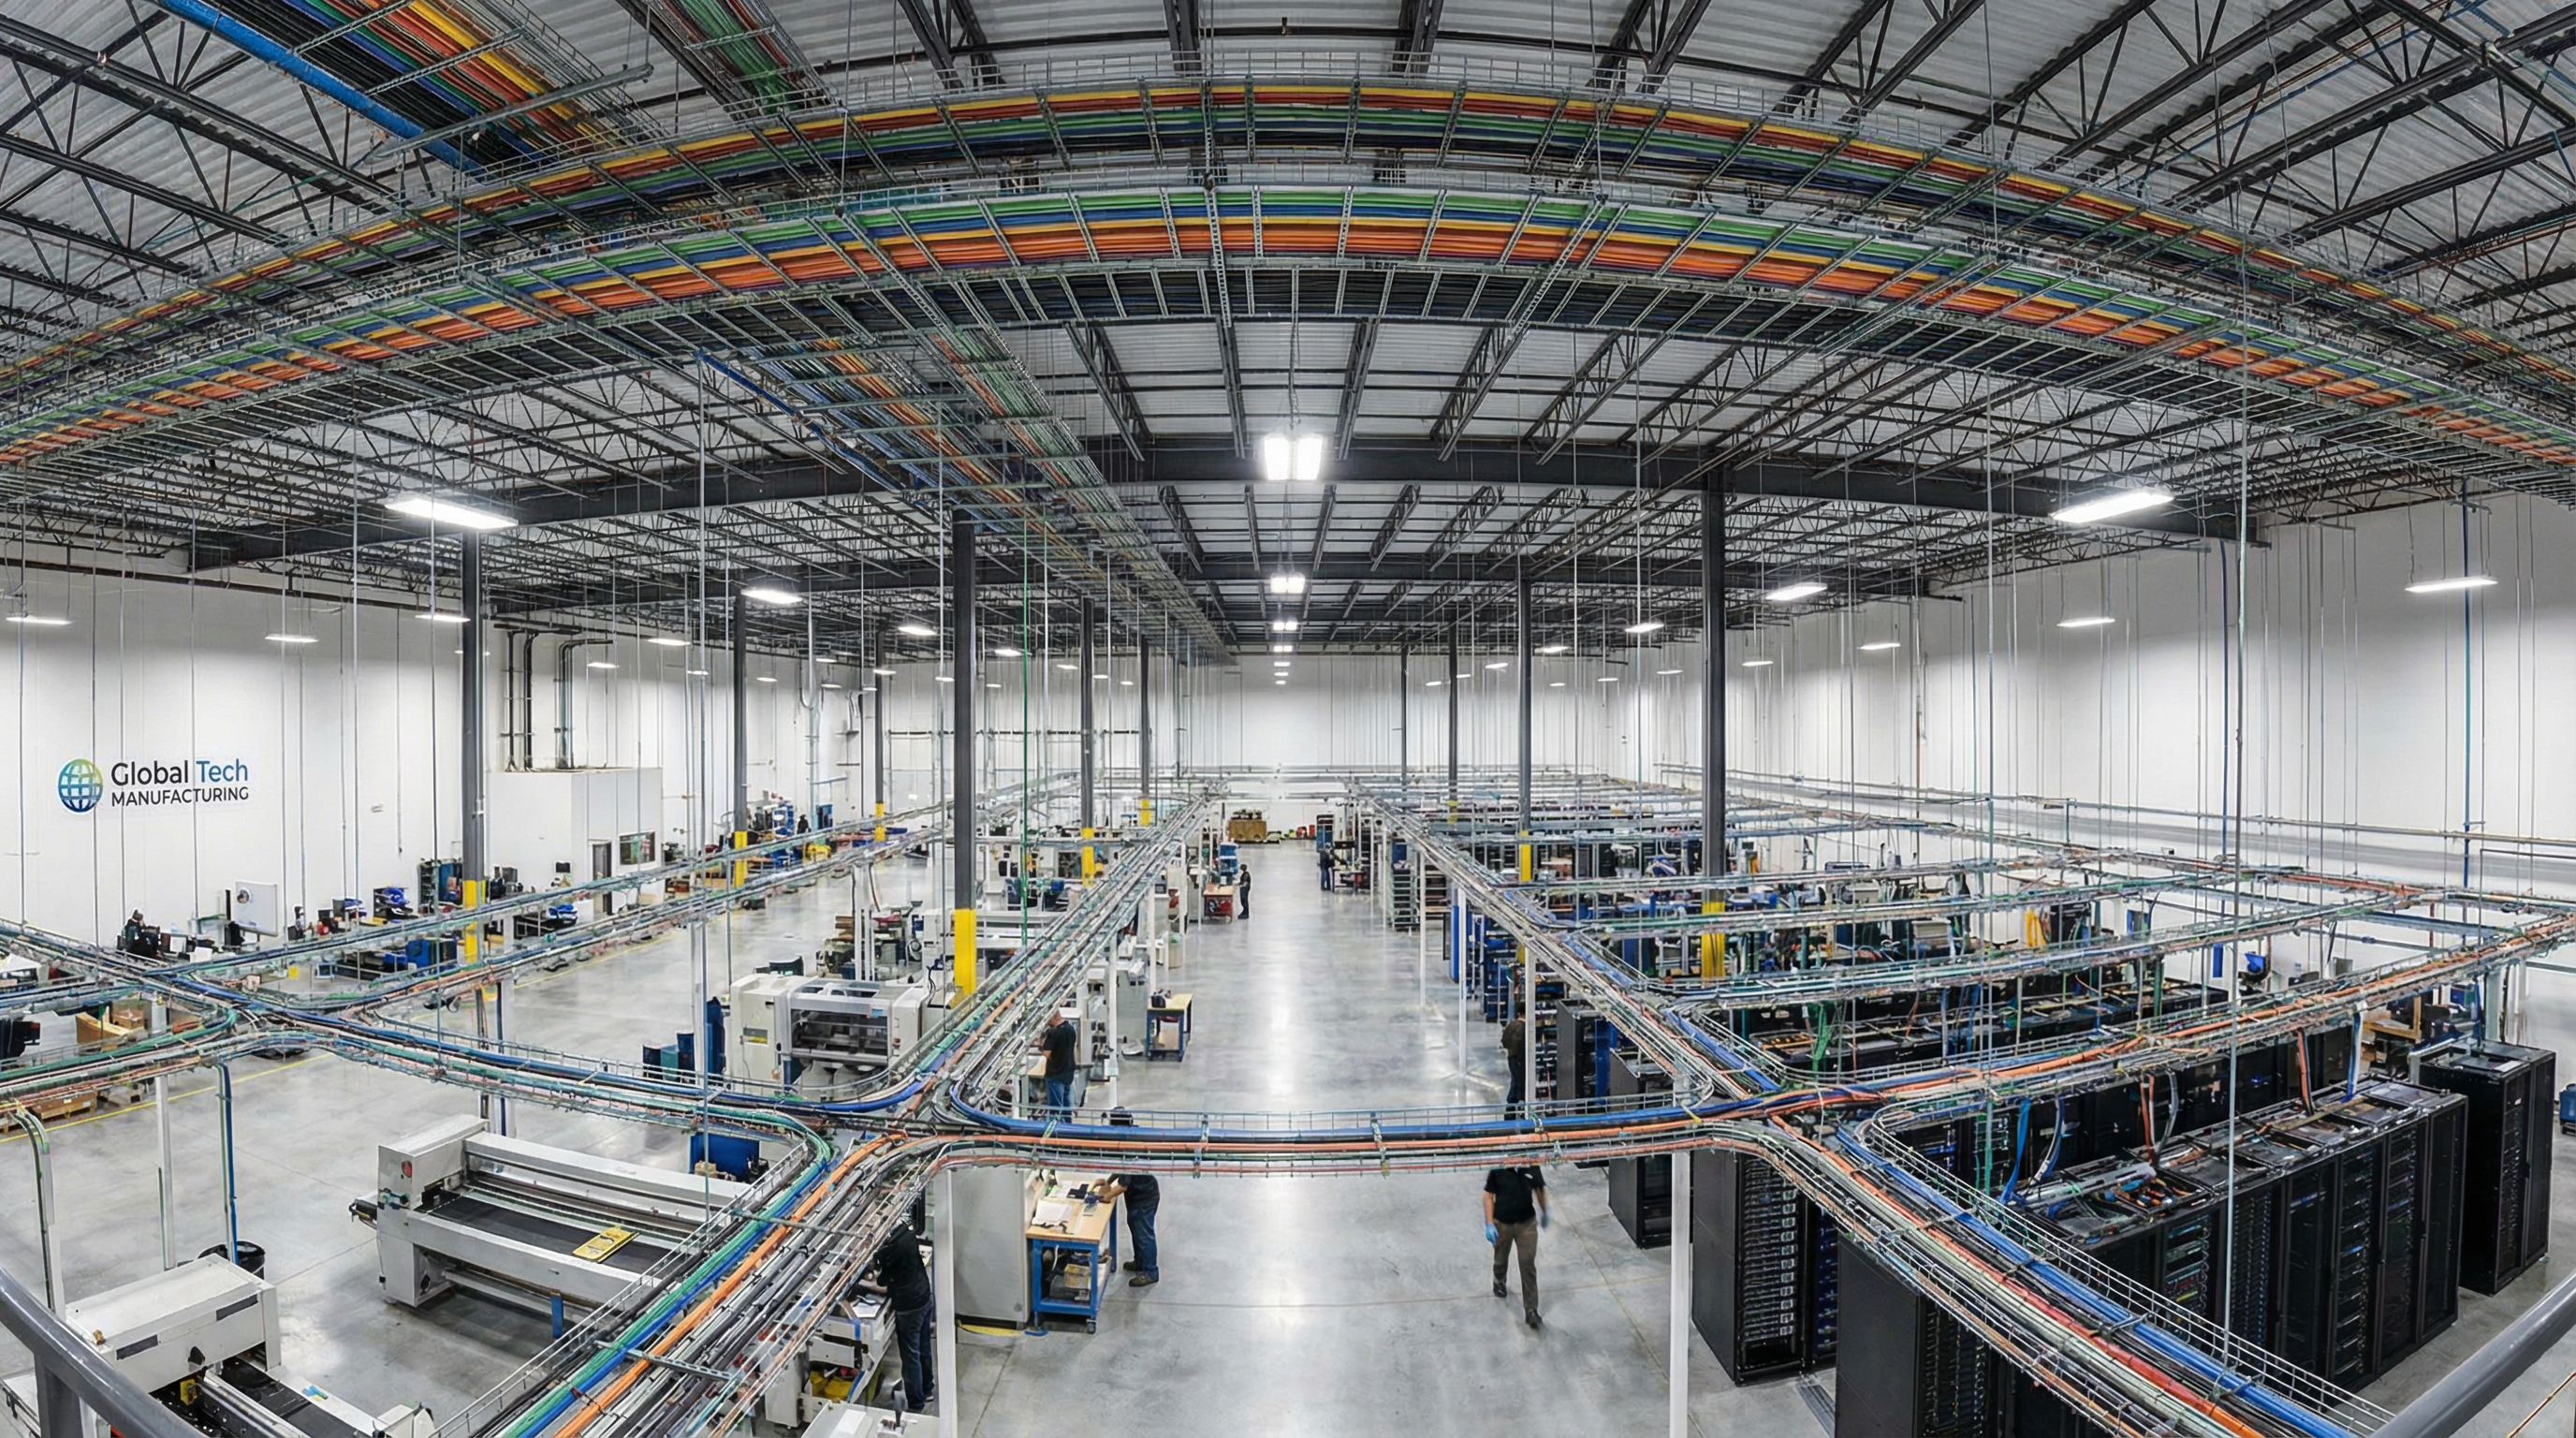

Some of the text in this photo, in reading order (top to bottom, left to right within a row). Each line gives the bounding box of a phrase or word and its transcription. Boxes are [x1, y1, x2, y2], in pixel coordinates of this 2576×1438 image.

[111, 758, 248, 785] Global Tech
[111, 786, 249, 806] MANUFACTURING
